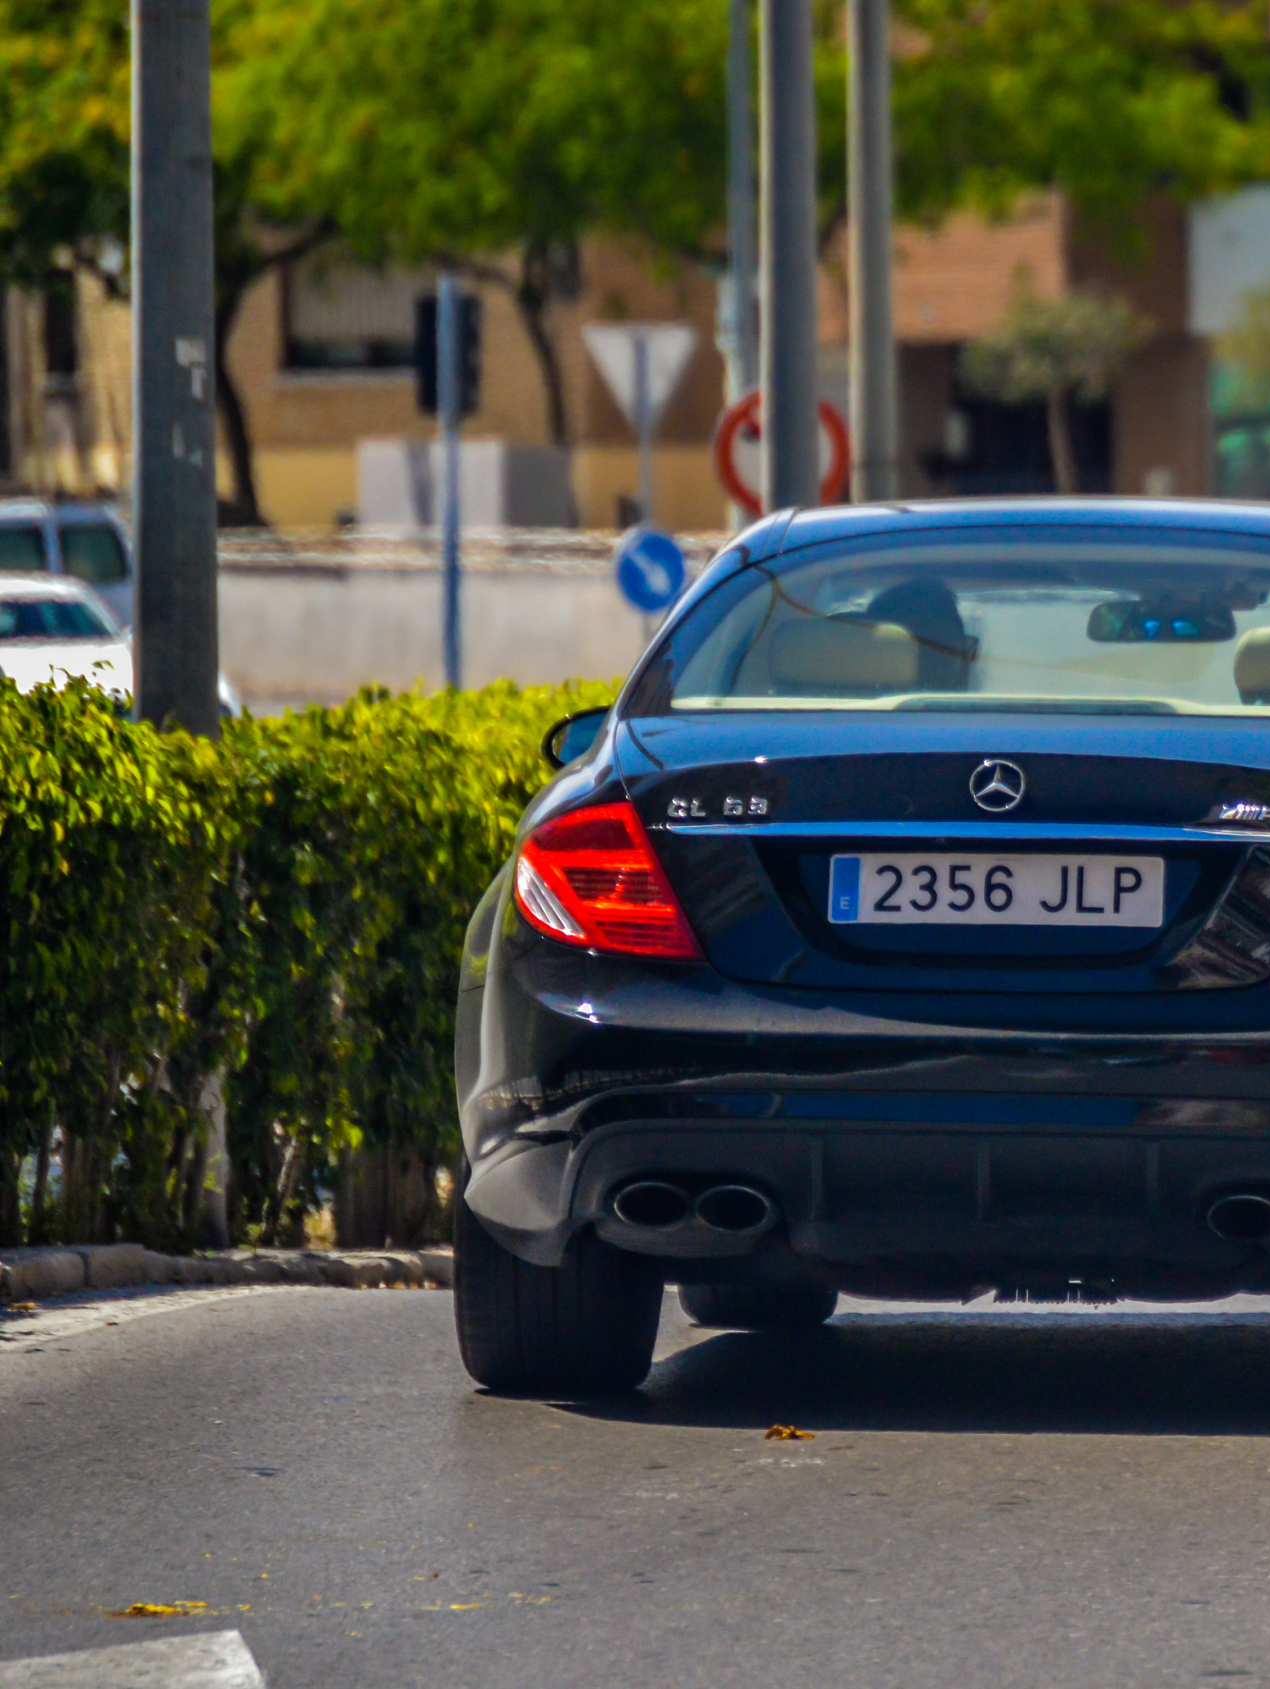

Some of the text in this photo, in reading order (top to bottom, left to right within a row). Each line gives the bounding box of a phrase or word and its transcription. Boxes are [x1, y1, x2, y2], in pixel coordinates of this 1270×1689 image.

[667, 796, 768, 817] CL 63
[873, 864, 1143, 914] 2356 JLP
[839, 896, 850, 910] E
